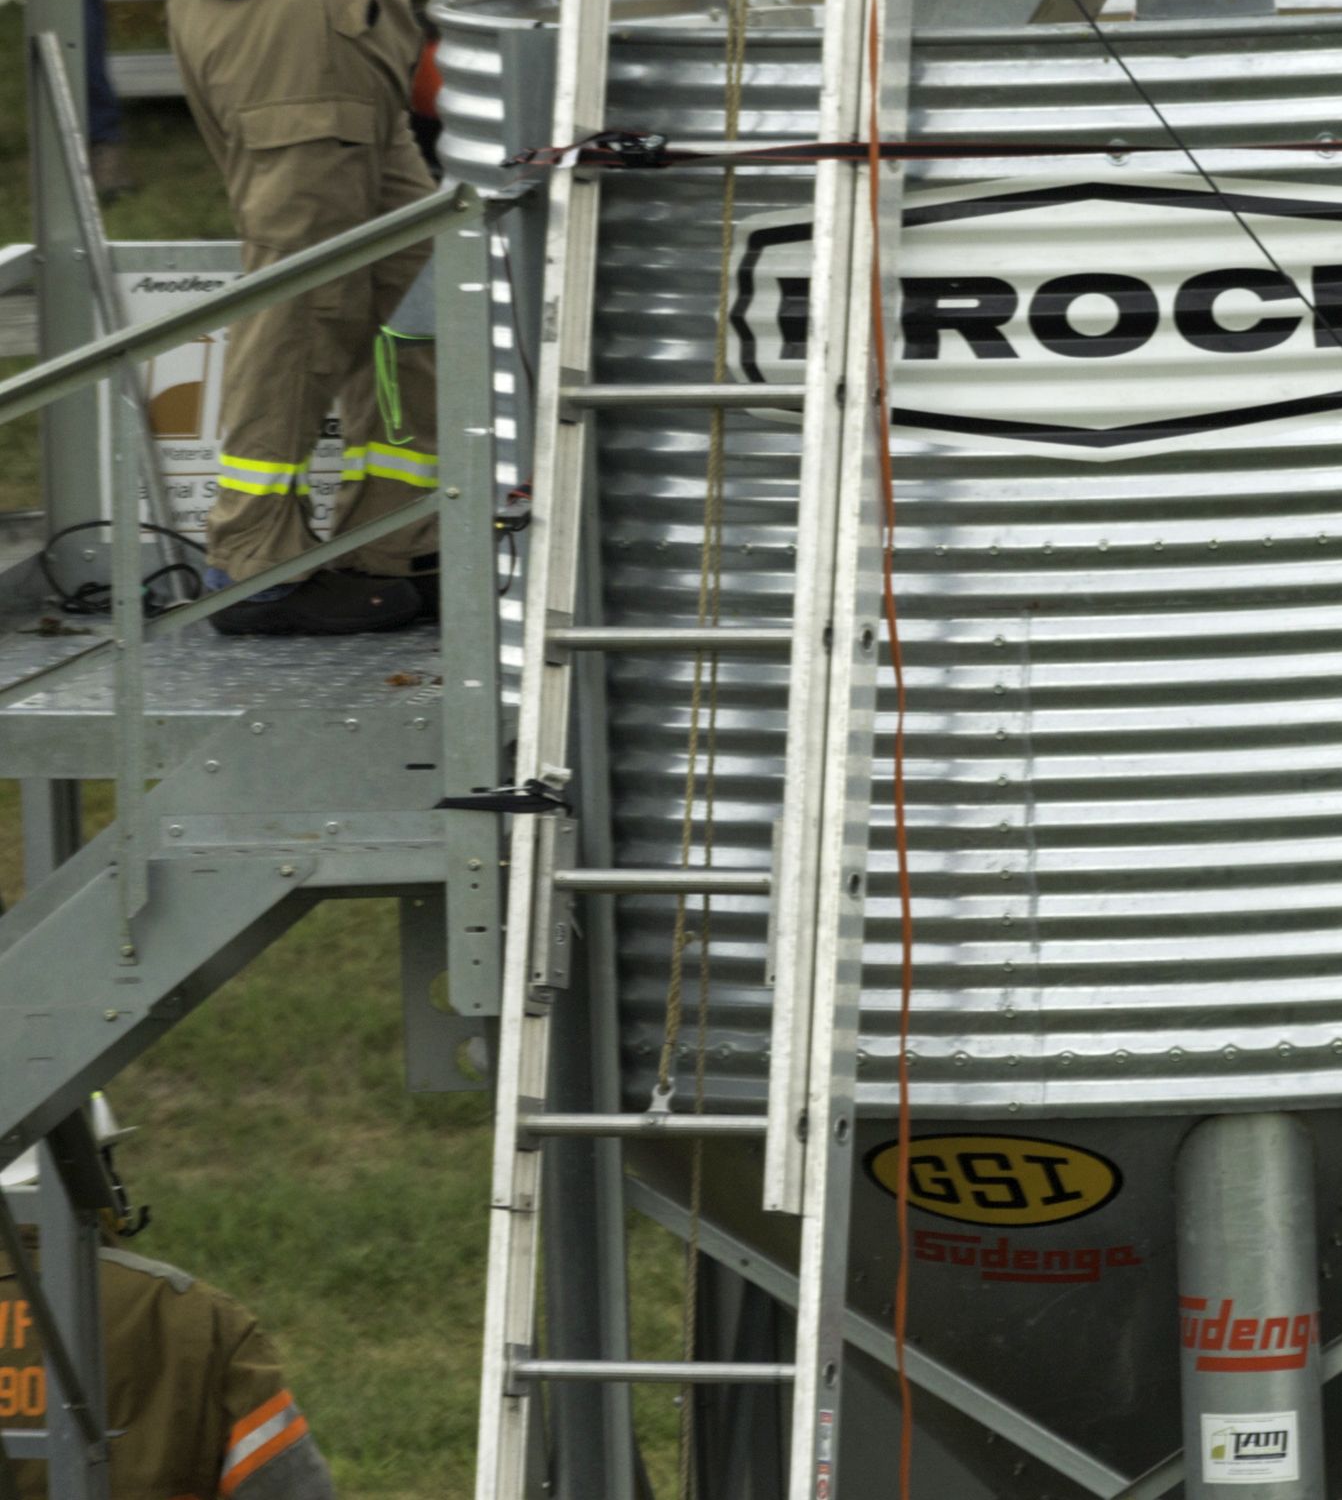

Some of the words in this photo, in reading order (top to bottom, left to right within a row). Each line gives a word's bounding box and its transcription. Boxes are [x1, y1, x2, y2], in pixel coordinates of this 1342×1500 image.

[908, 1152, 1084, 1210] GSI
[914, 1230, 1143, 1283] Sudenga
[1179, 1296, 1321, 1373] udeng
